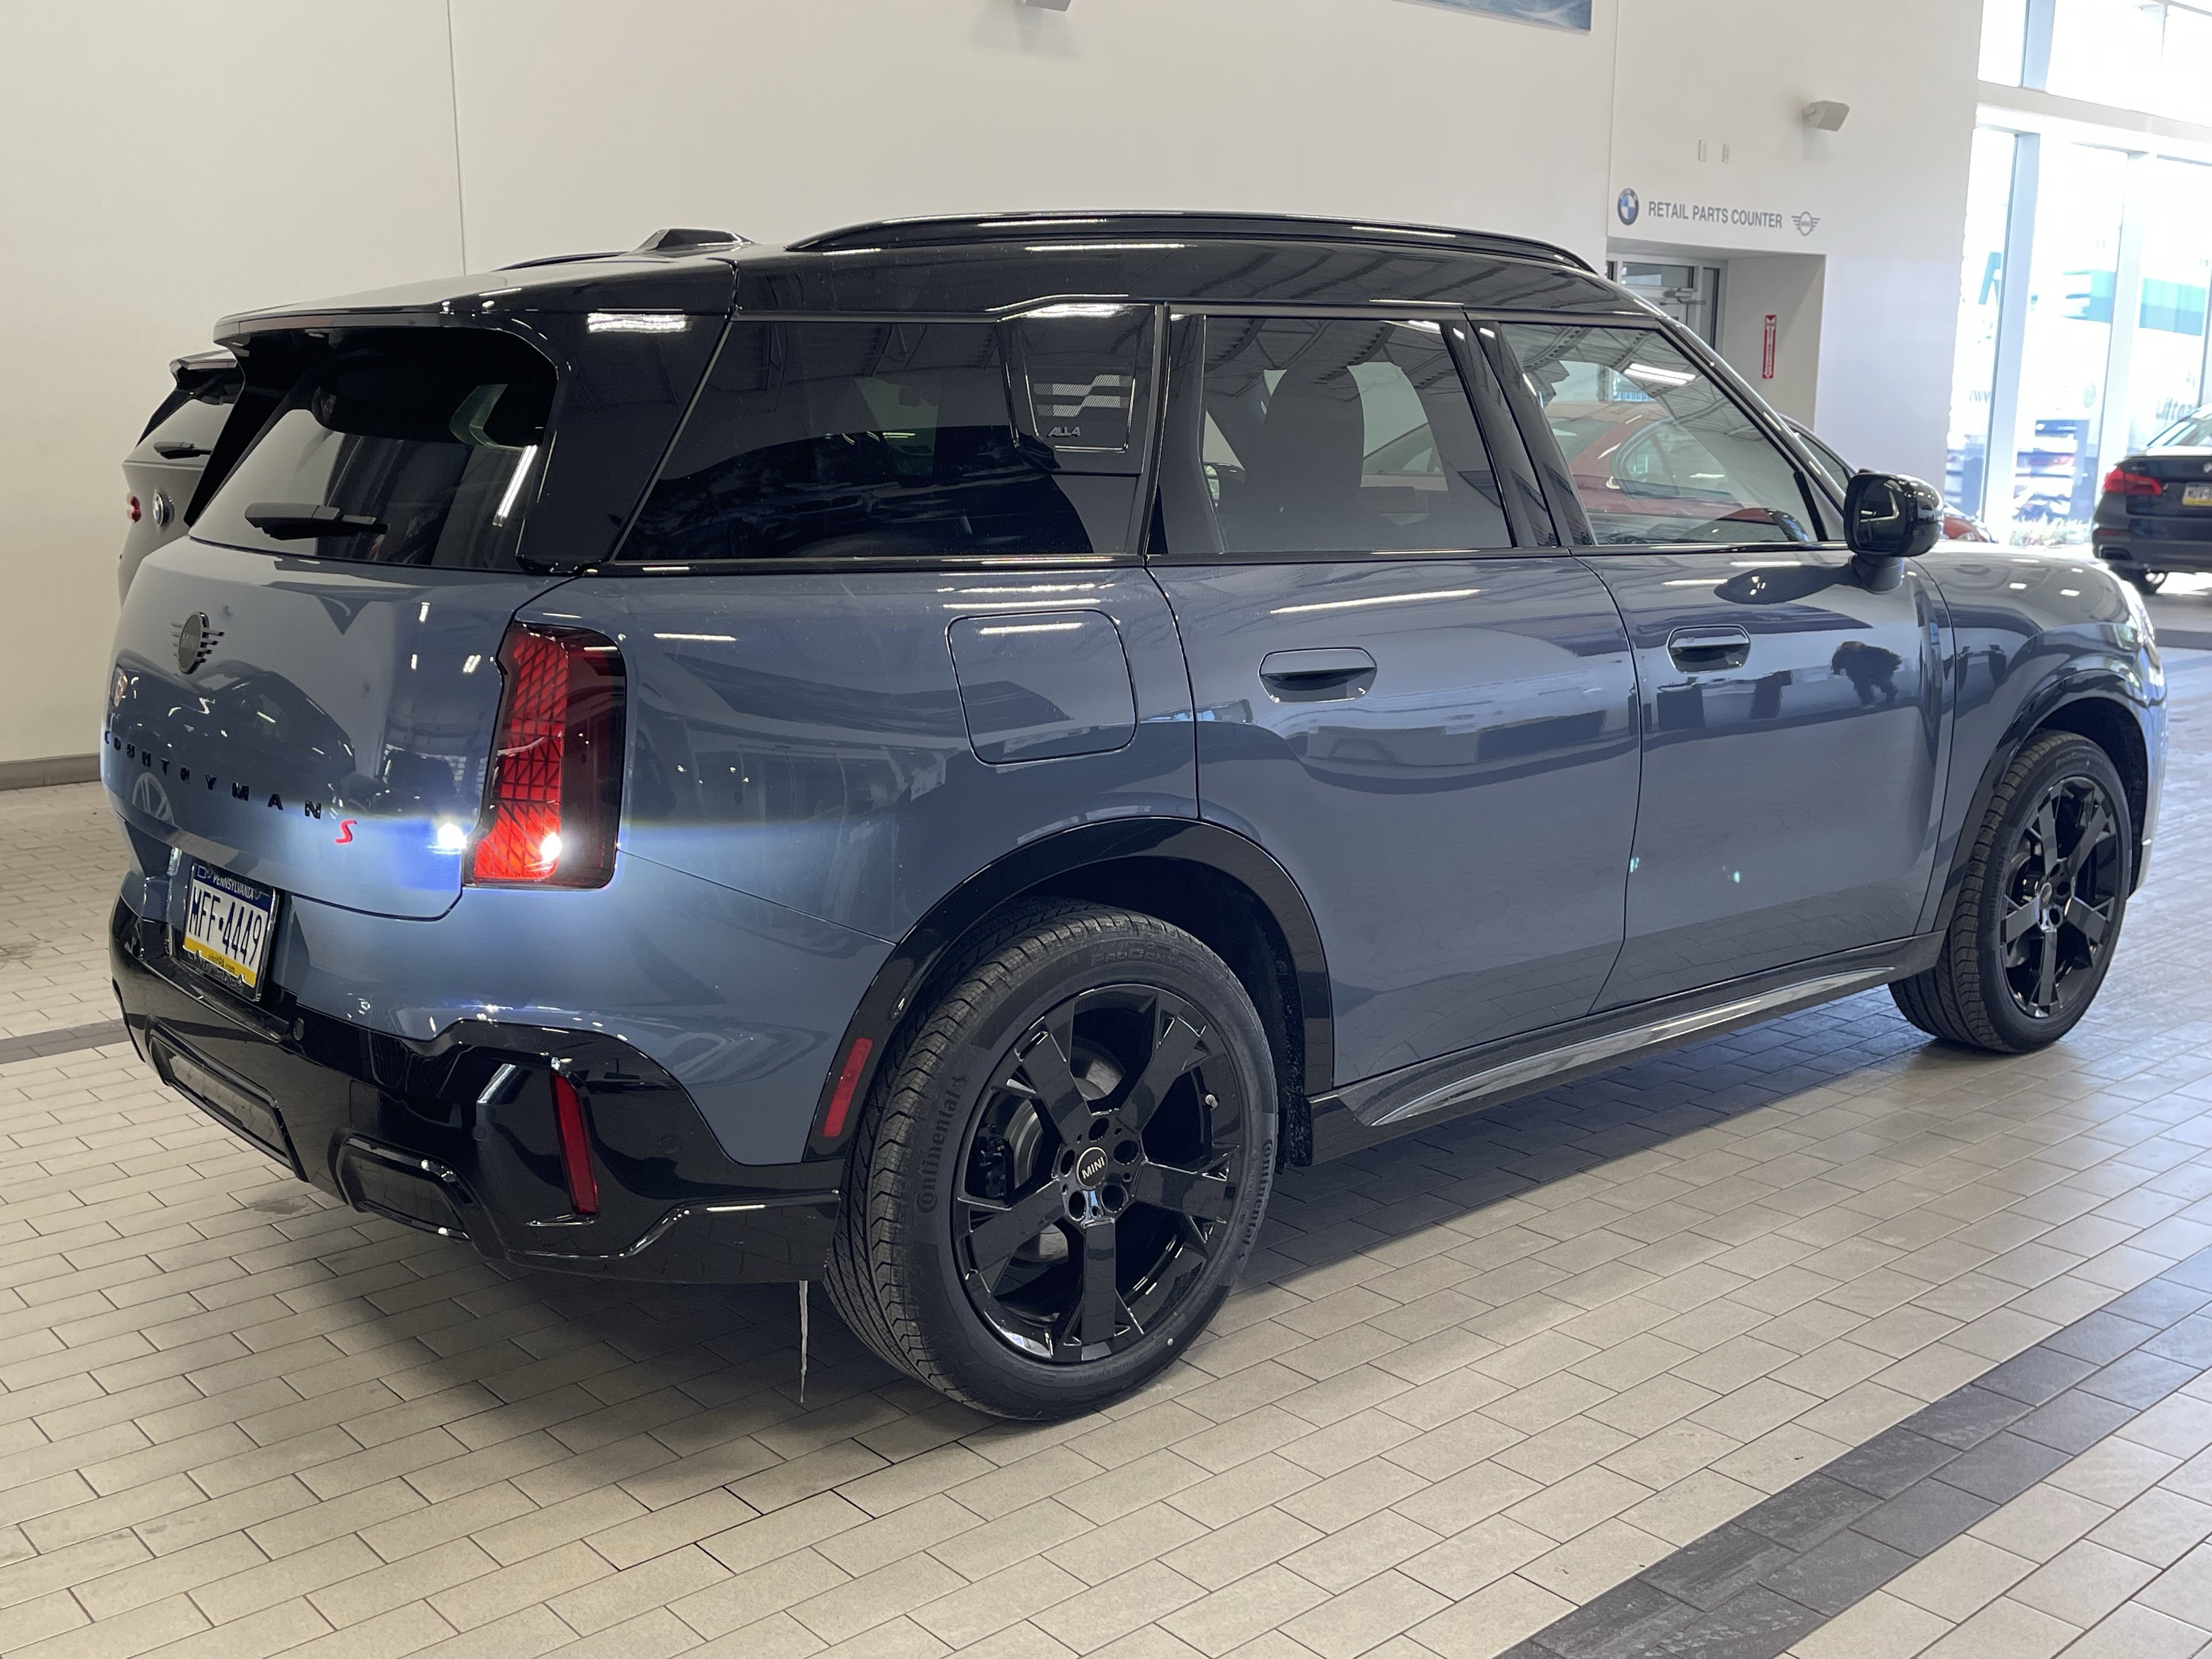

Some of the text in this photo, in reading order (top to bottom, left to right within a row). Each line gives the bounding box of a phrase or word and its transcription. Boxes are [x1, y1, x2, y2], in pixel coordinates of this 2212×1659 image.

[1648, 201, 1782, 228] RETAIL PARTS COUNTER
[335, 819, 358, 844] S
[213, 873, 254, 900] PENNSYLVANIA
[1081, 1156, 1105, 1180] MINI
